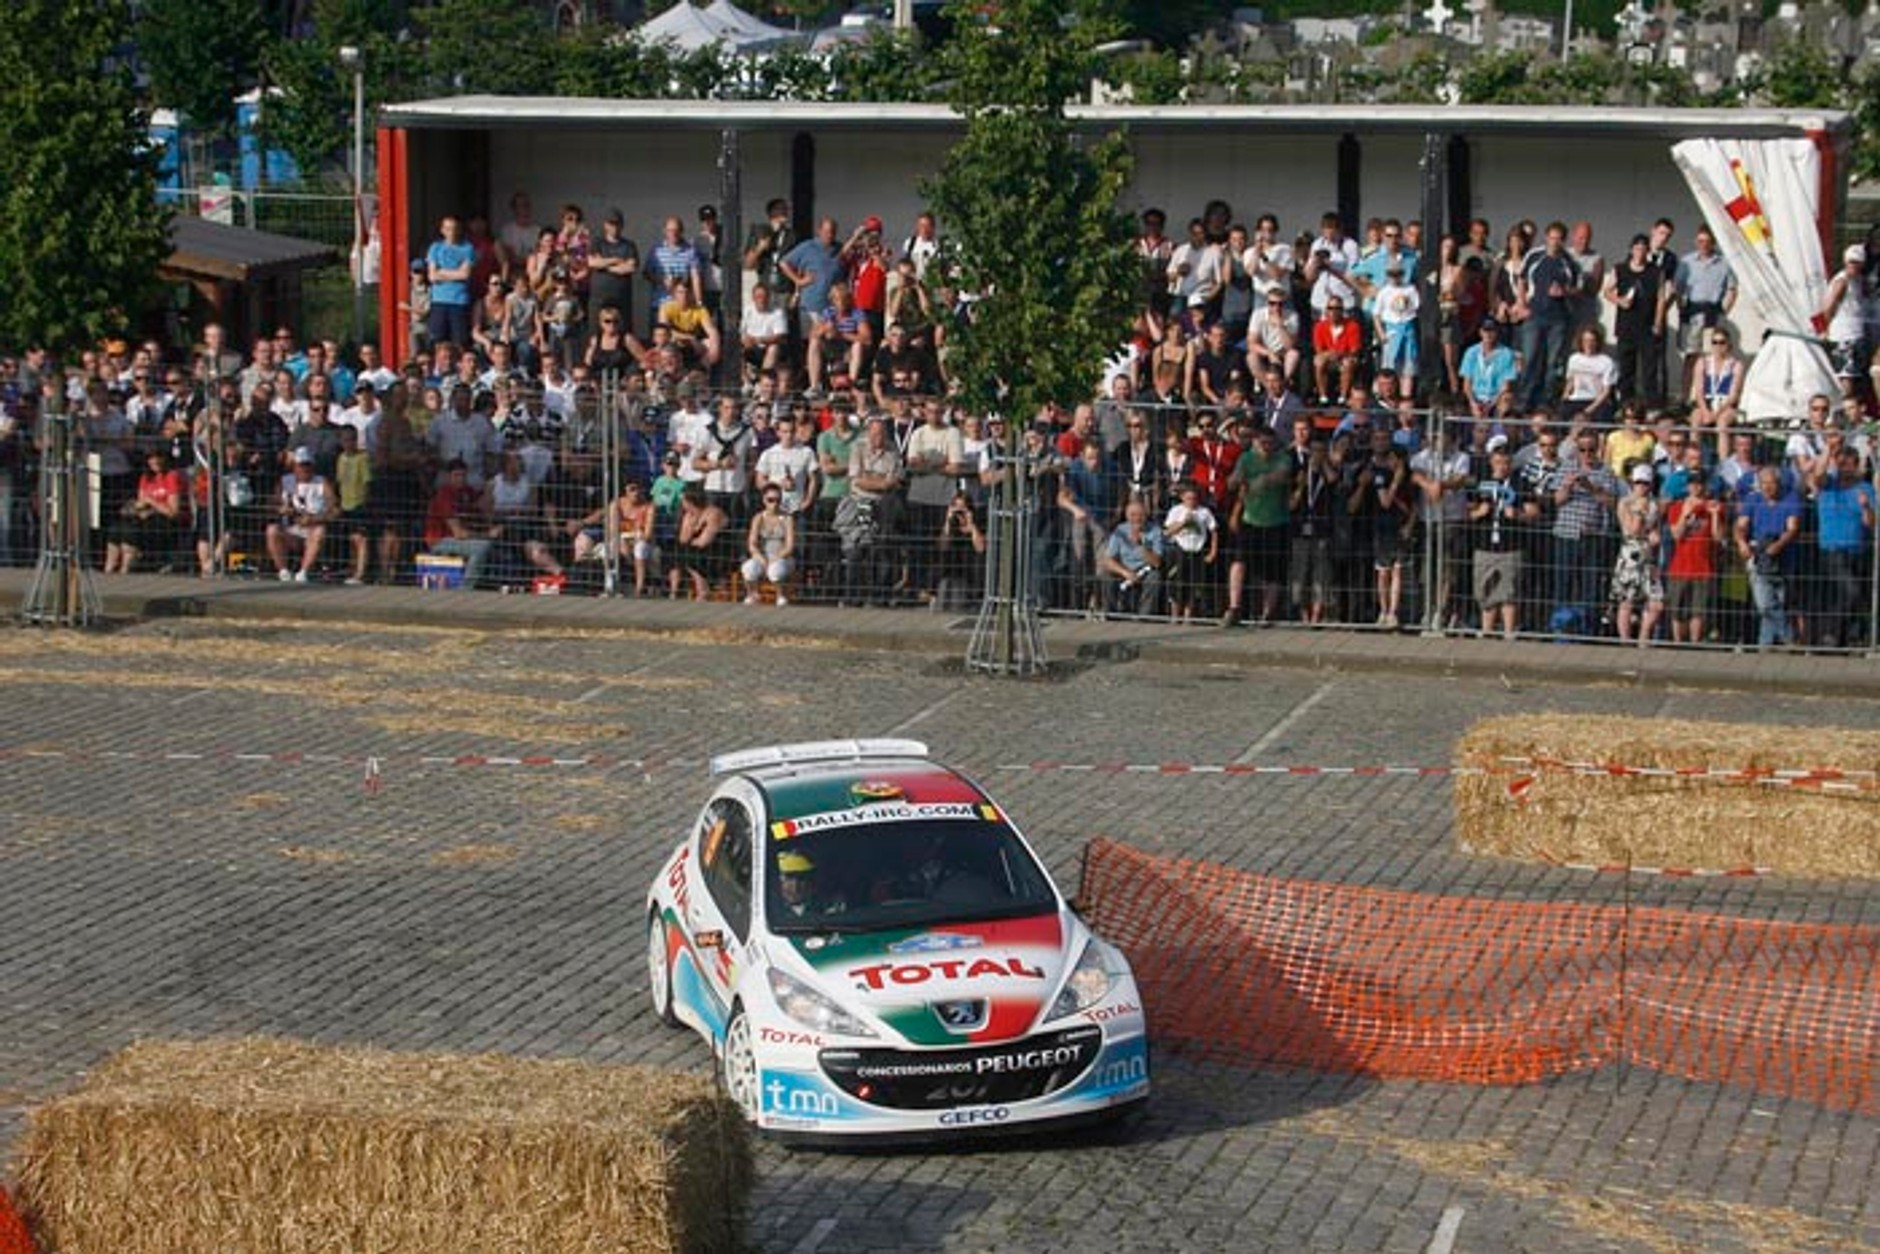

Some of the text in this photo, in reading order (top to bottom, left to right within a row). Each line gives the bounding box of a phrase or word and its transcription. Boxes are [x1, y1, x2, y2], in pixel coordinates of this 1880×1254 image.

[848, 957, 1046, 990] TOTAL
[1080, 1003, 1140, 1022] TOTAL
[759, 1027, 827, 1047] TOTAL
[856, 1044, 1083, 1078] CONCESSIONARIOS PEUGEOT
[764, 1079, 839, 1116] tmn
[938, 1106, 1010, 1125] GEFCO
